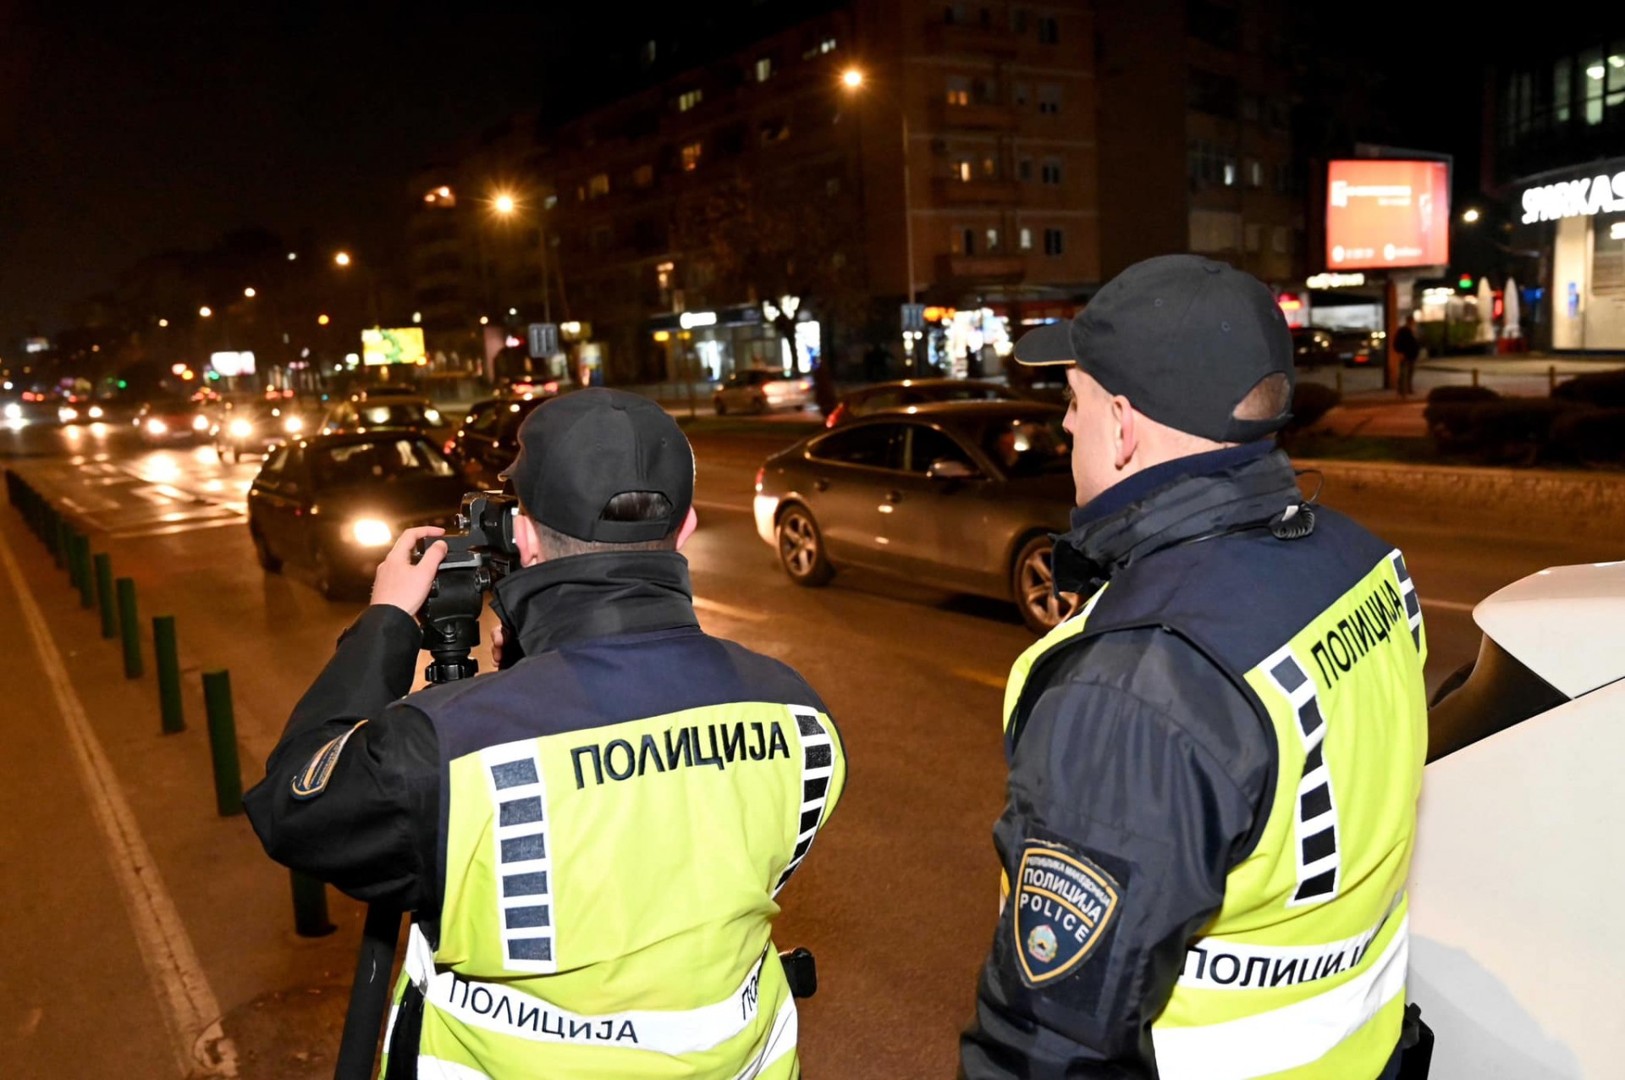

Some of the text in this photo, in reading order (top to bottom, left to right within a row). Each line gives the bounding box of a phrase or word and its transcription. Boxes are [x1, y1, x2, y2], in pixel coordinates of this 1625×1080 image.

[1311, 579, 1404, 689] ПОЛИЦИЈА
[570, 721, 790, 790] ПОЛИЦИЈА
[1019, 892, 1090, 943] POLICE
[1023, 867, 1102, 922] ПОЛИЦИЈА
[449, 976, 639, 1044] ПОЛИЦИЈА
